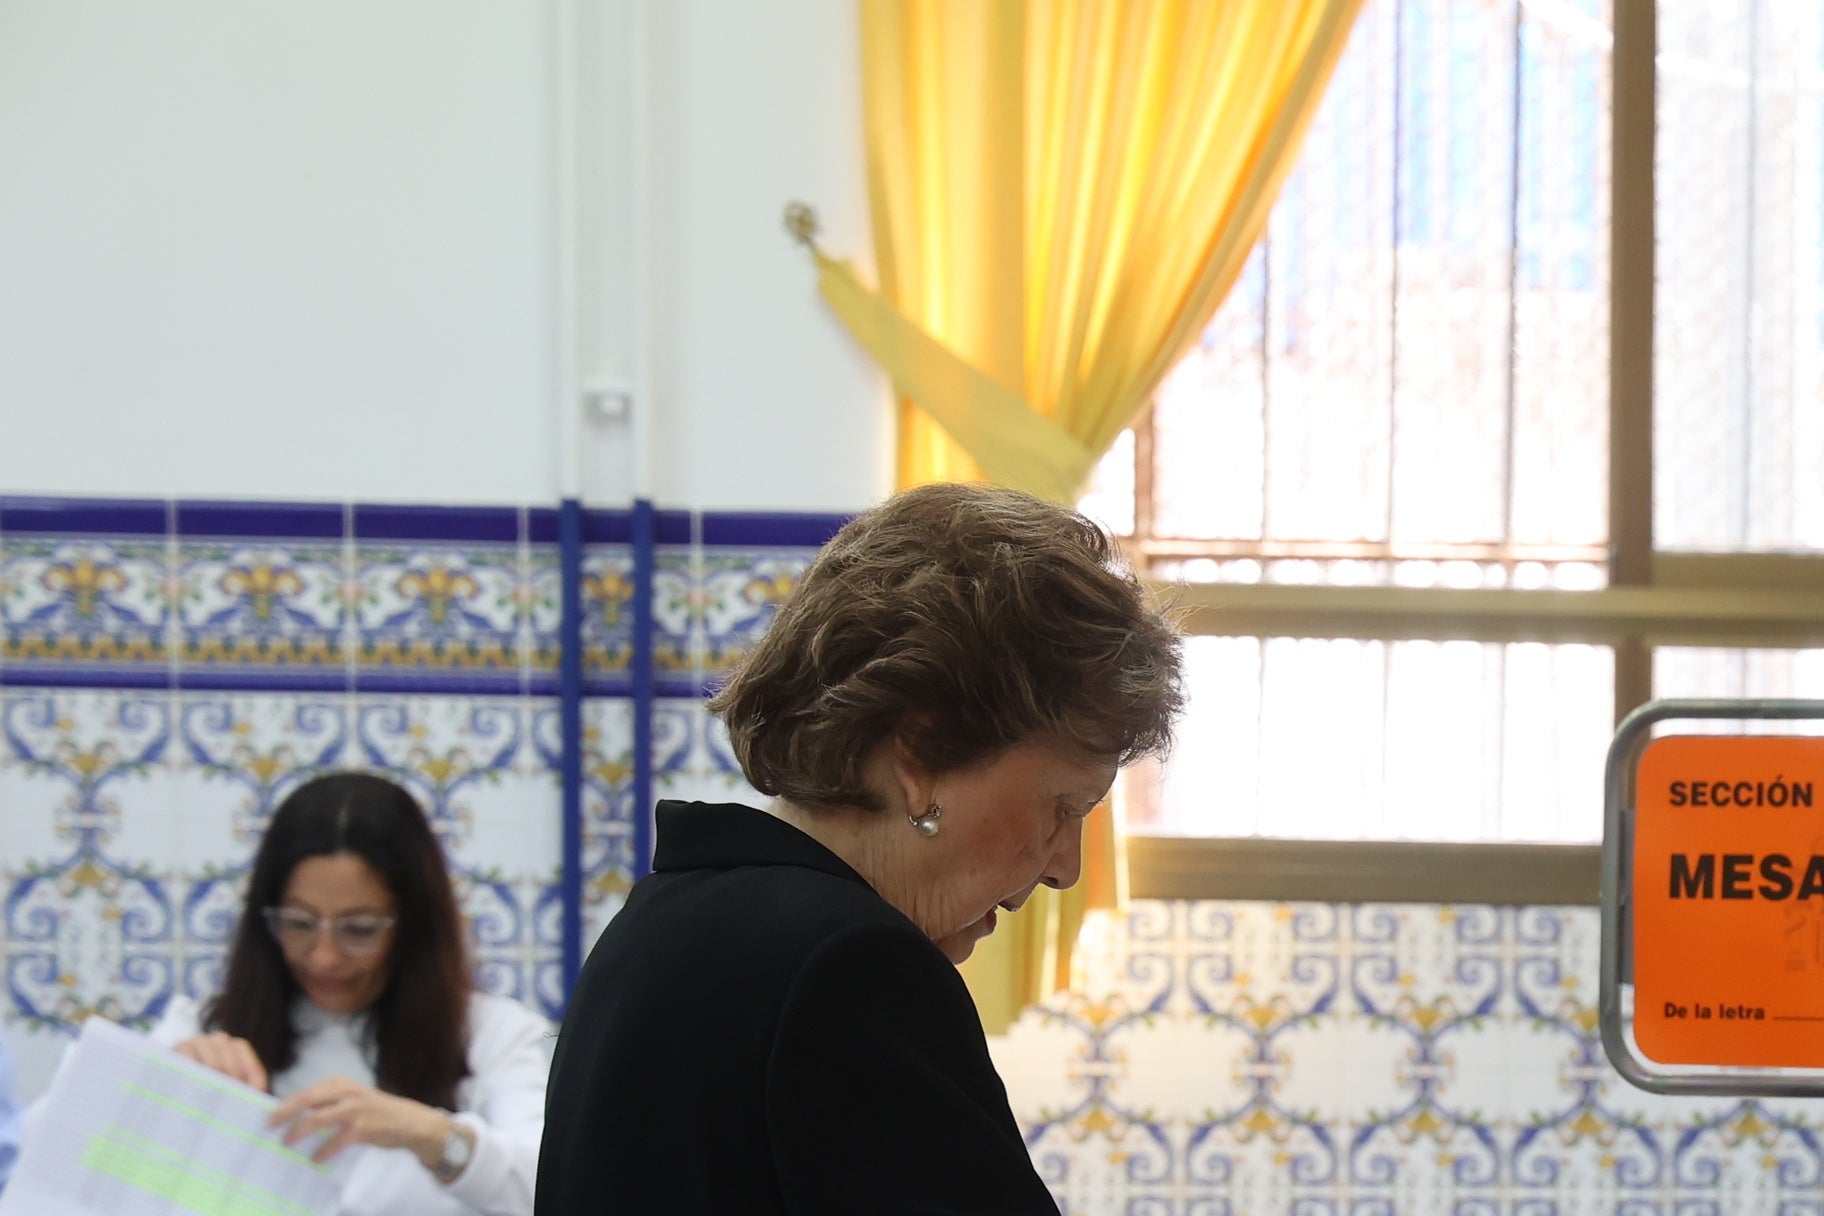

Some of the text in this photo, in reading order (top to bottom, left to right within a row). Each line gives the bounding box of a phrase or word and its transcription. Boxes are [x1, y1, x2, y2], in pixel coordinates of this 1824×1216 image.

[1669, 774, 1814, 808] SECCIÓN
[1663, 1002, 1688, 1020] De
[1694, 1003, 1712, 1020] la
[1718, 1003, 1766, 1021] letra
